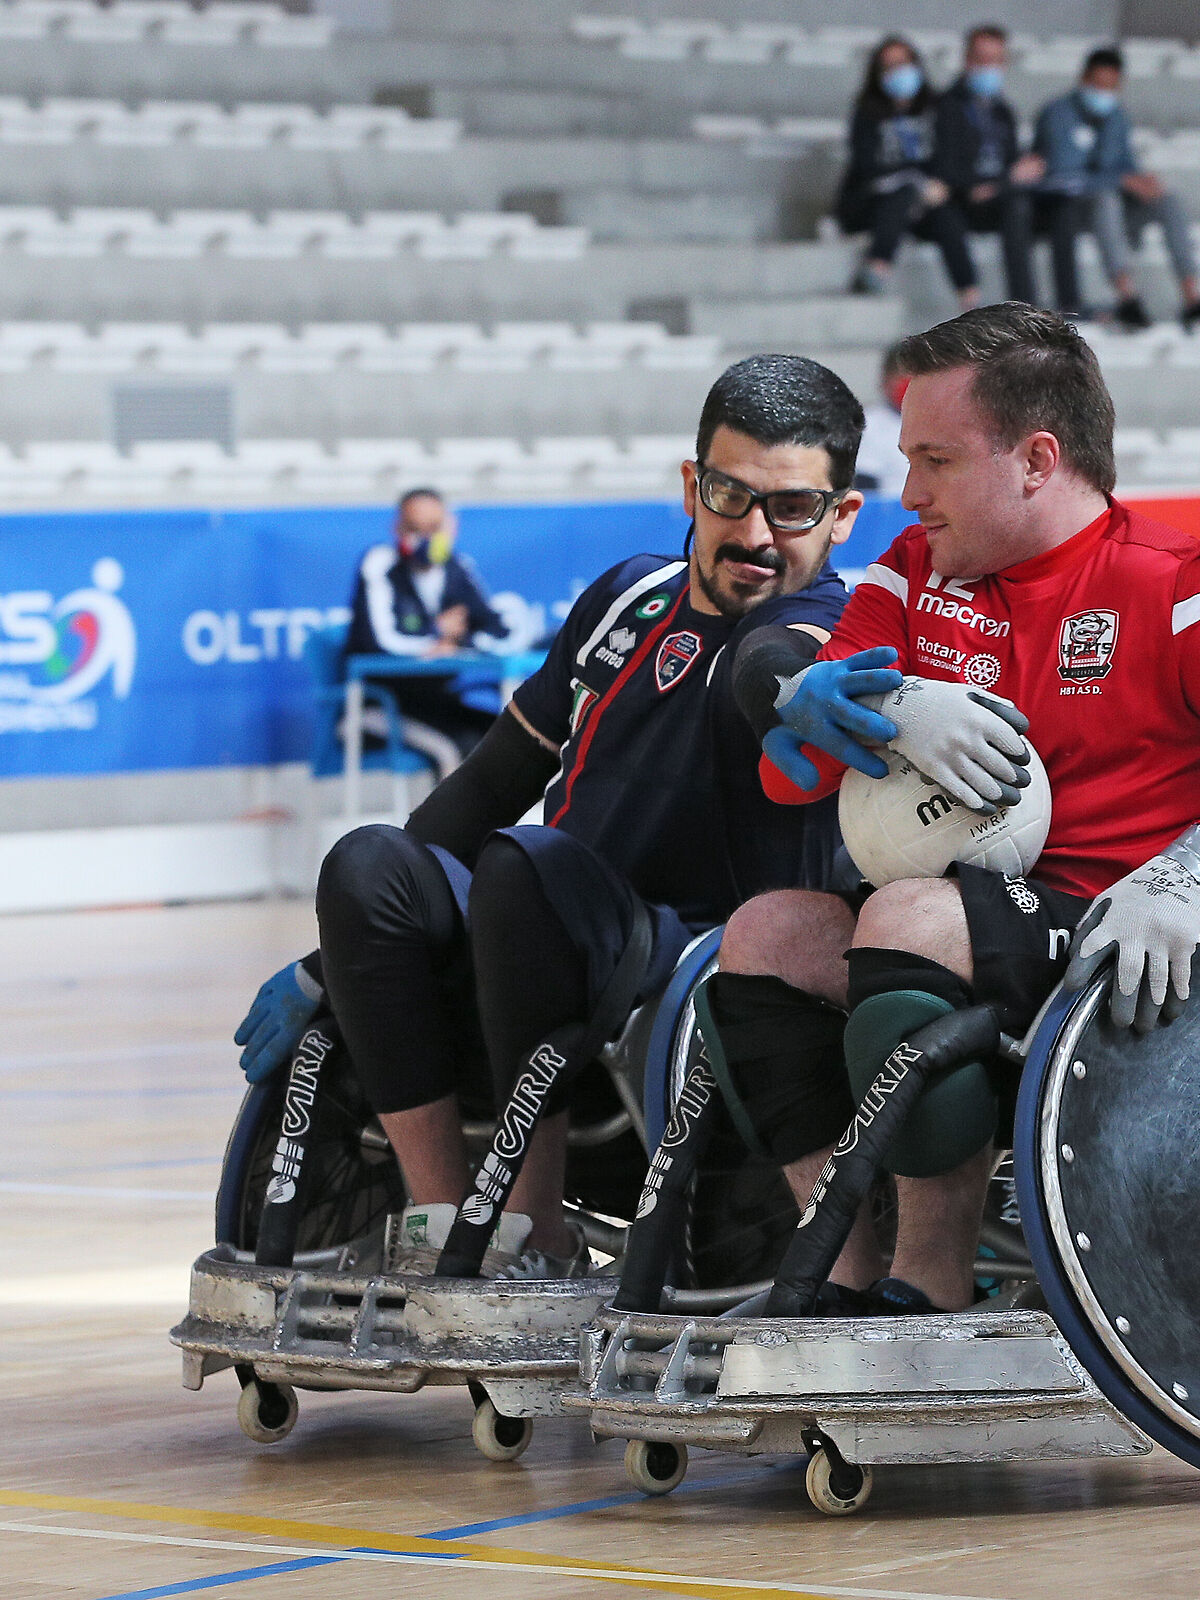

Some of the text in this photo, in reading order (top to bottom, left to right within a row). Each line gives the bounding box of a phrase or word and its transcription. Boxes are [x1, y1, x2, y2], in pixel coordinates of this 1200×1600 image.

[916, 592, 1011, 638] macron
[916, 636, 967, 664] Rotary
[969, 808, 1008, 838] IWRF
